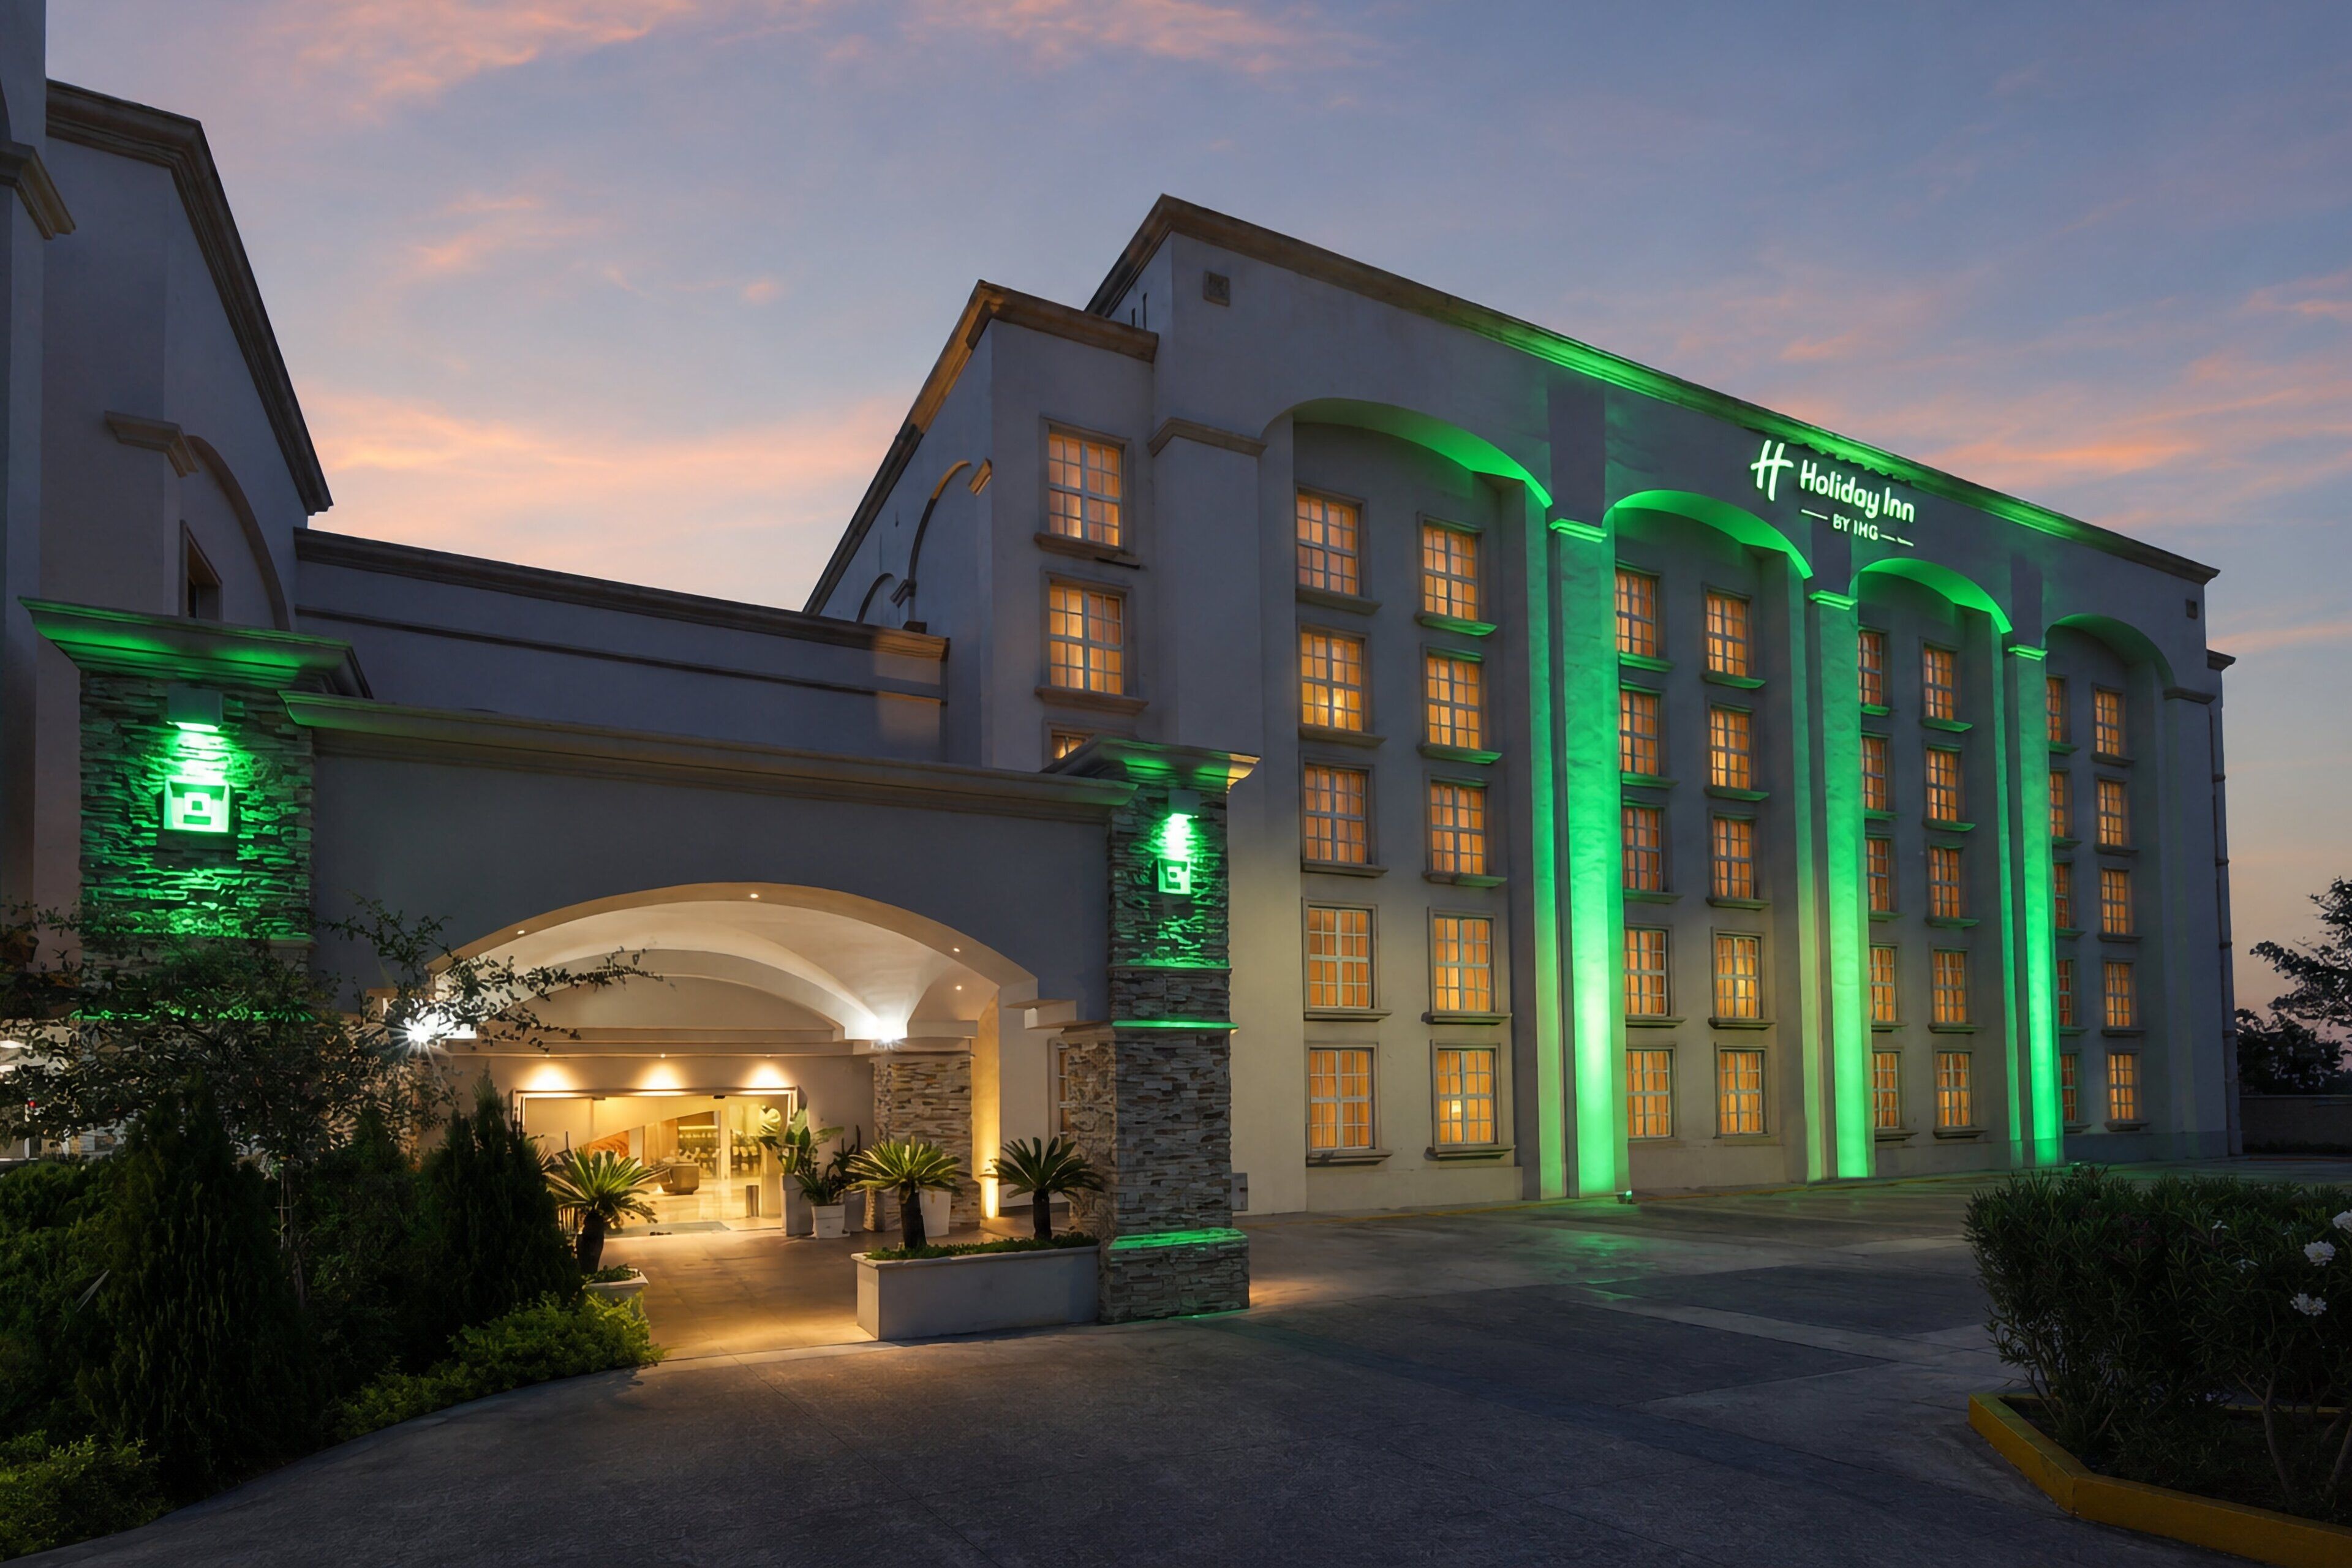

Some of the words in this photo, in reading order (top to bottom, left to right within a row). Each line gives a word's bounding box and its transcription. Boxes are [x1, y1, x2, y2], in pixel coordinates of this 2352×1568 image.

[1800, 459, 1880, 519] Holiday
[1883, 487, 1915, 522] Inn
[1833, 513, 1850, 532] BY
[1854, 520, 1879, 540] IHG
